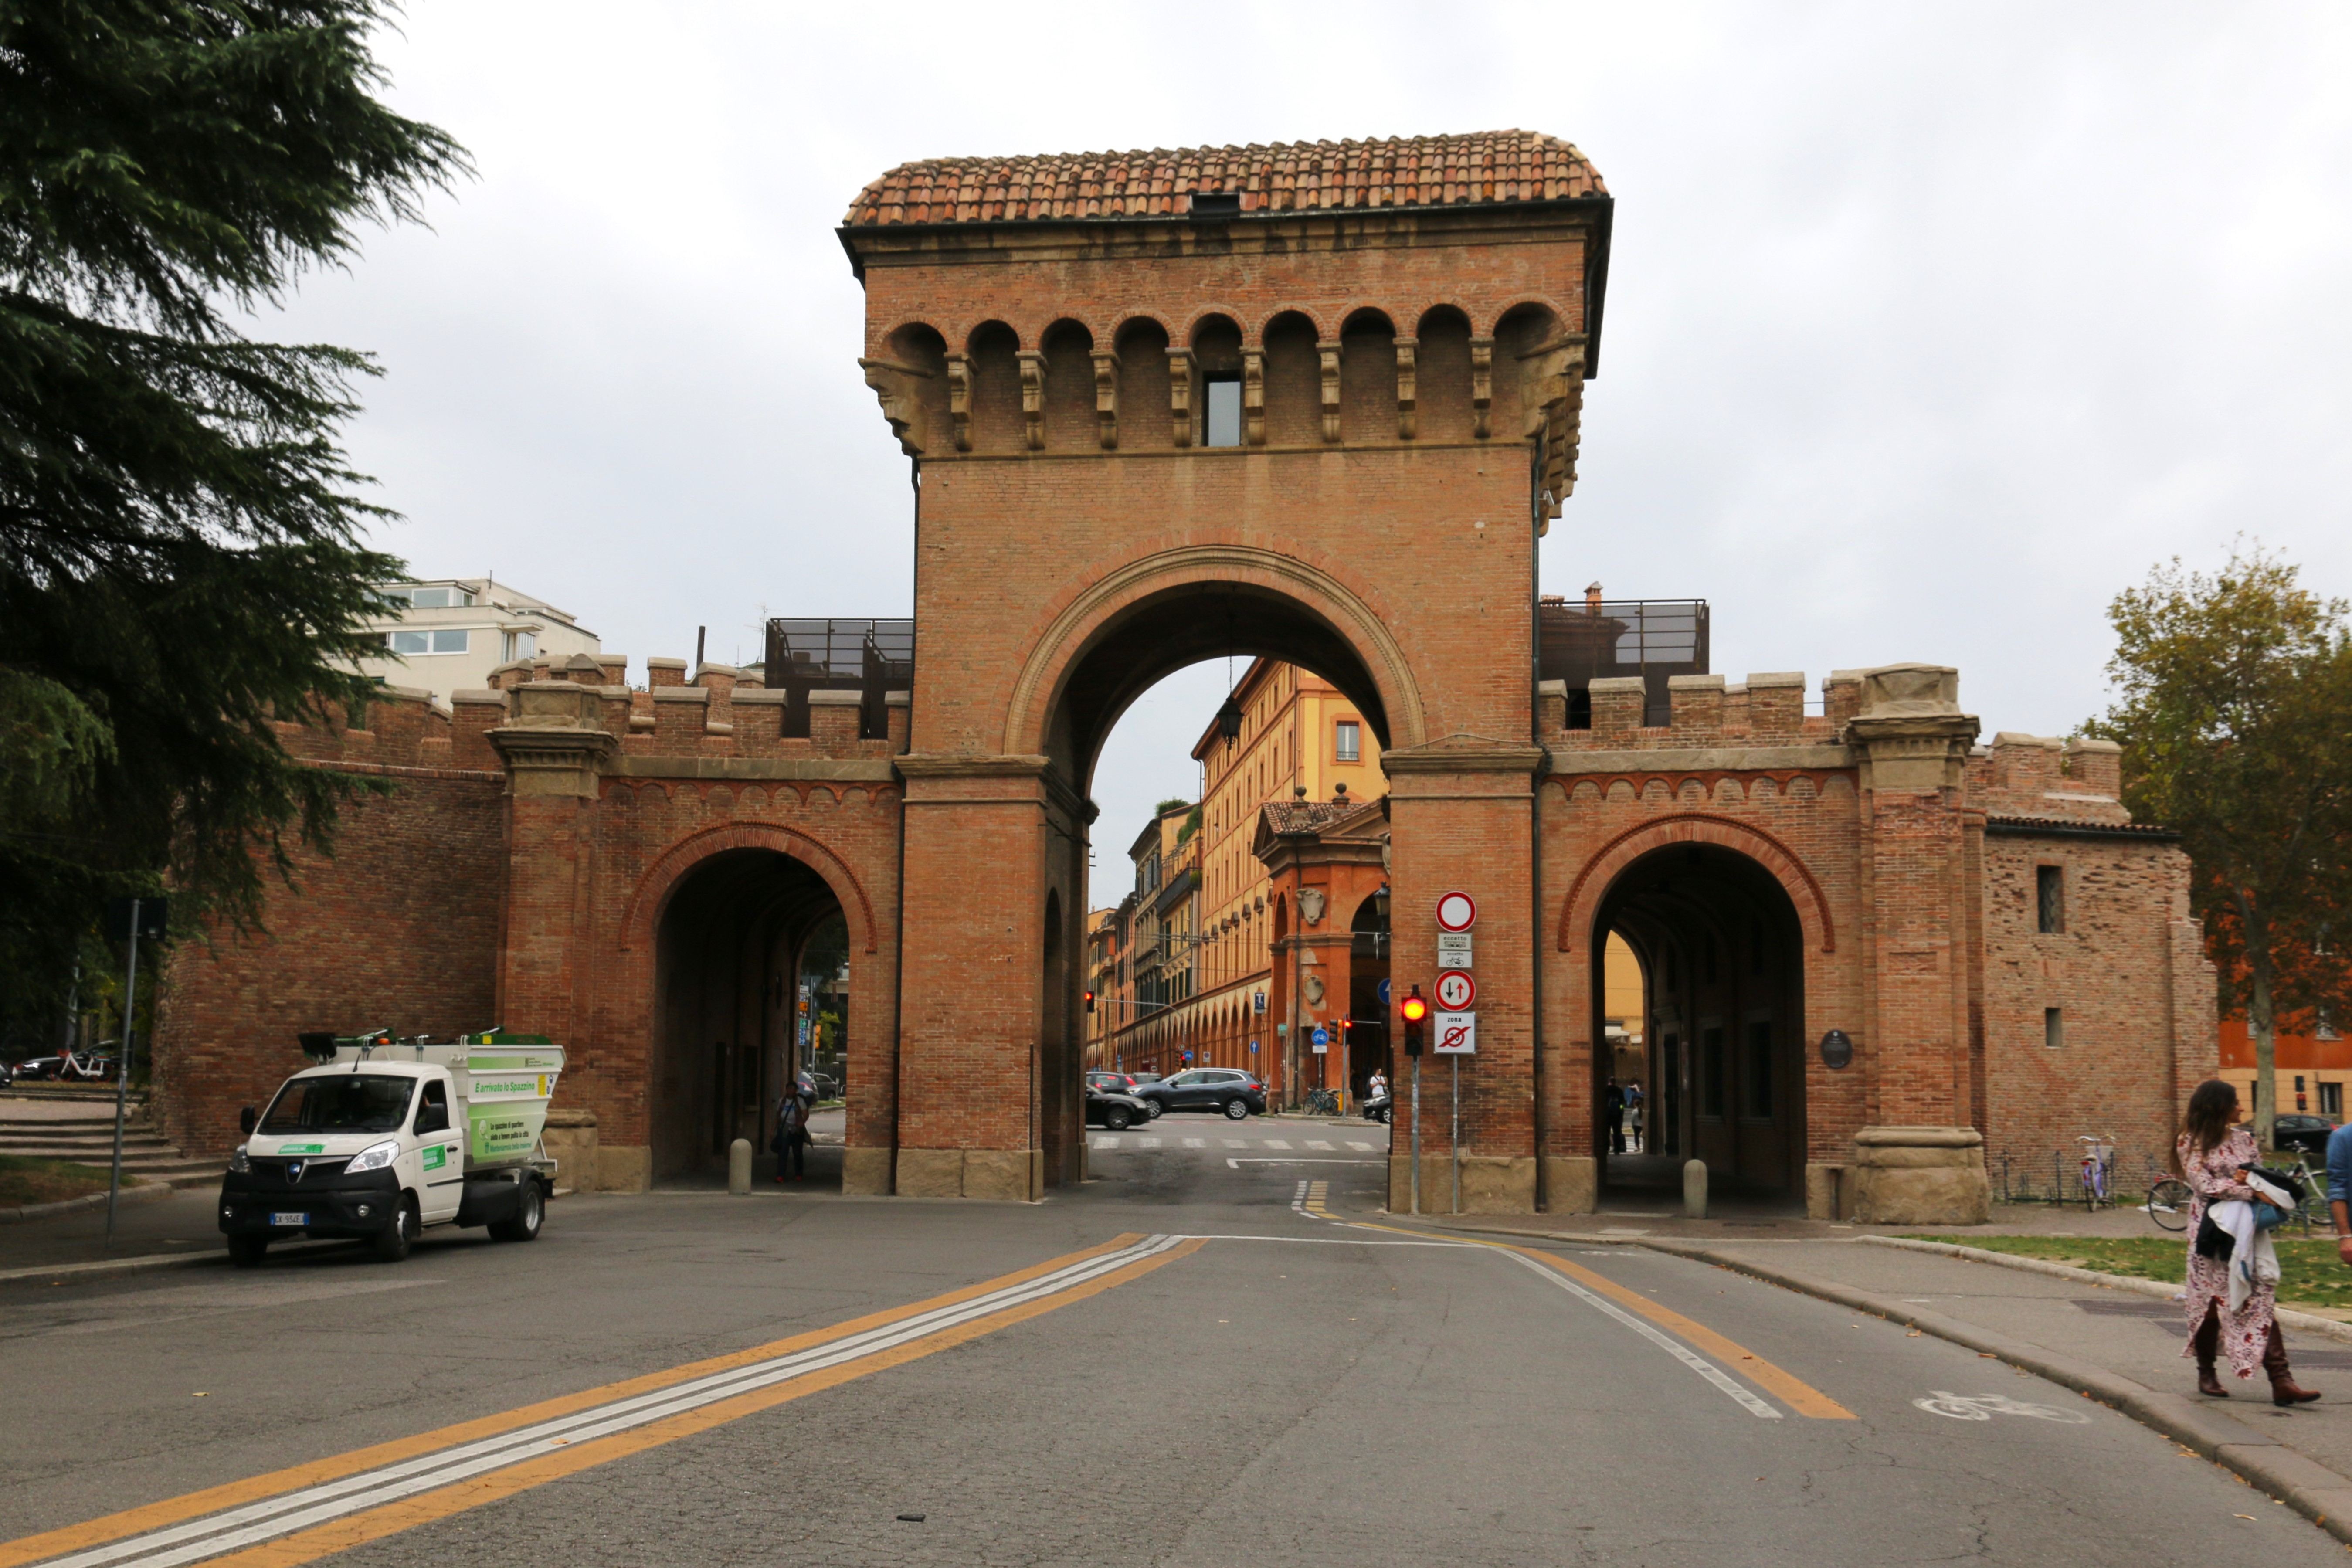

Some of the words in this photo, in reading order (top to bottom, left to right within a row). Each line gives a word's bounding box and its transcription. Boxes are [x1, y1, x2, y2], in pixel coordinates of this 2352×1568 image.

[475, 1081, 480, 1093] È
[480, 1083, 503, 1093] arrivato
[504, 1082, 509, 1091] lo
[510, 1081, 535, 1093] Spazzino
